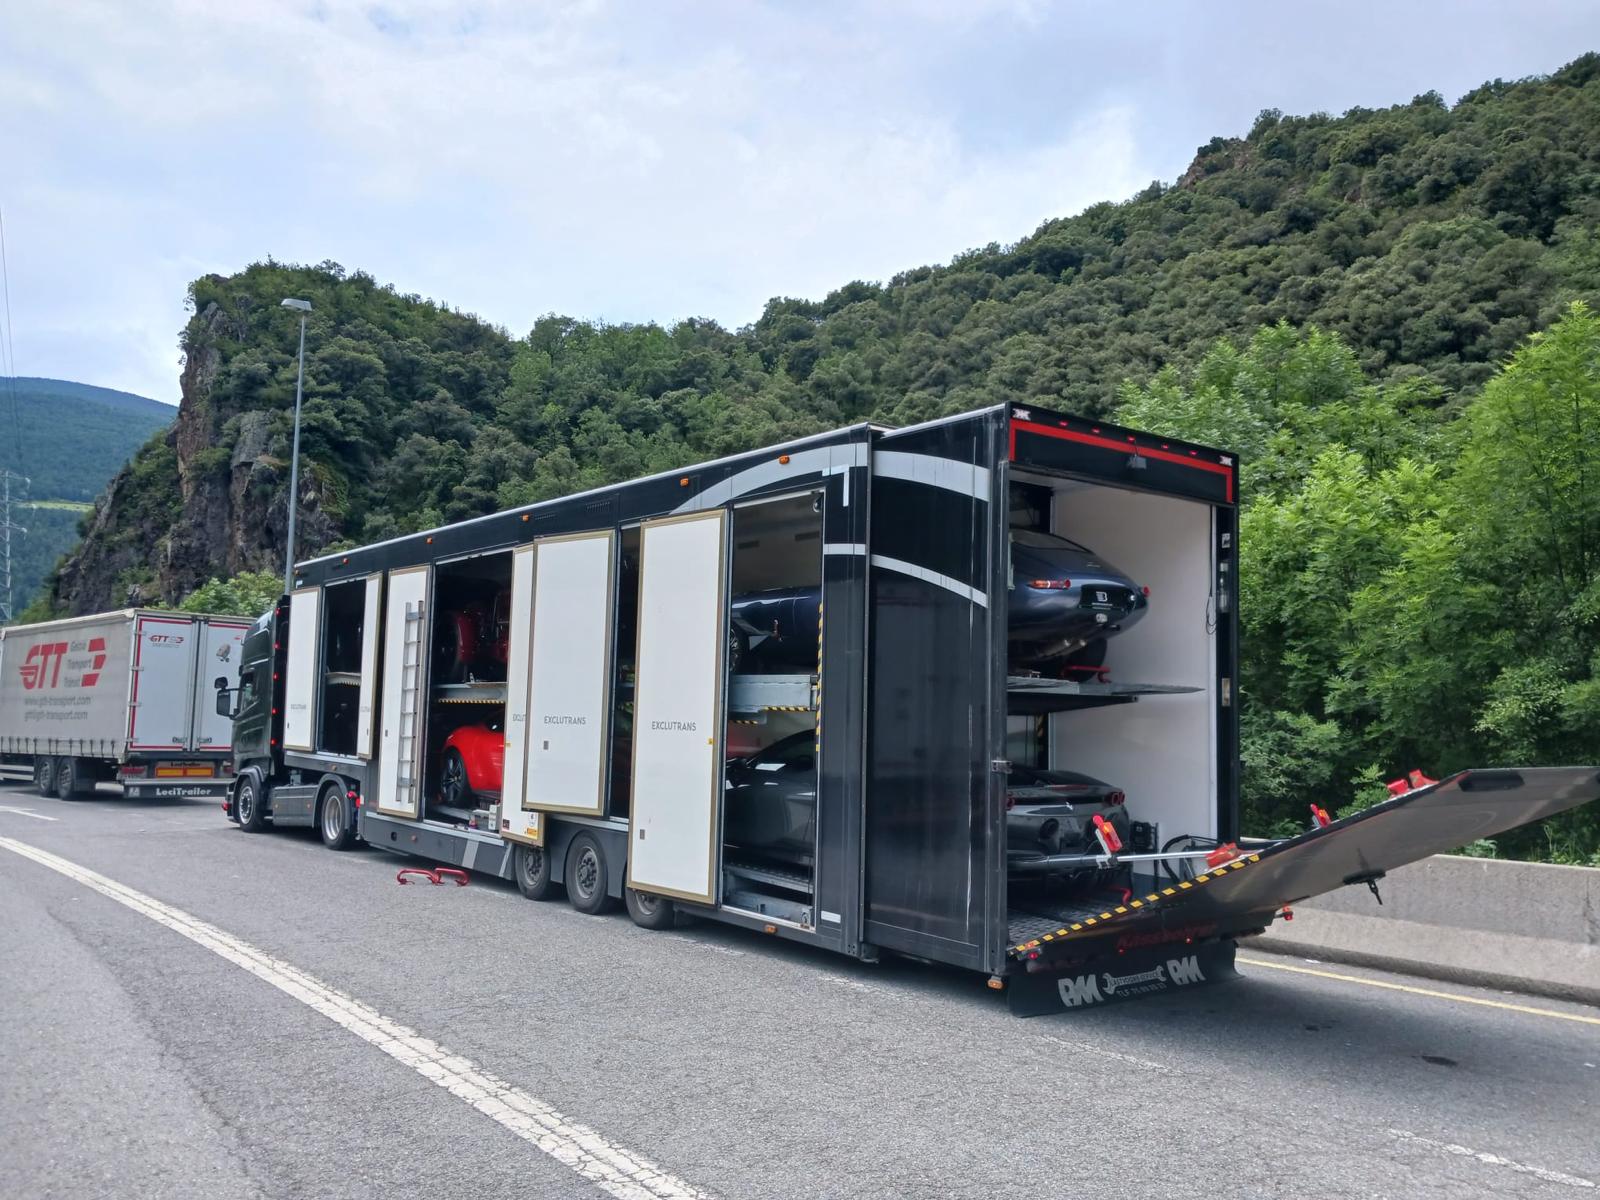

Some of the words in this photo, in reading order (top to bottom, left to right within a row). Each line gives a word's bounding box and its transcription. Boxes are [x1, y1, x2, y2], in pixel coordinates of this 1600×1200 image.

[19, 641, 68, 689] GTT
[544, 716, 586, 725] EXCLUTRANS
[651, 721, 697, 732] EXCLUTRANS
